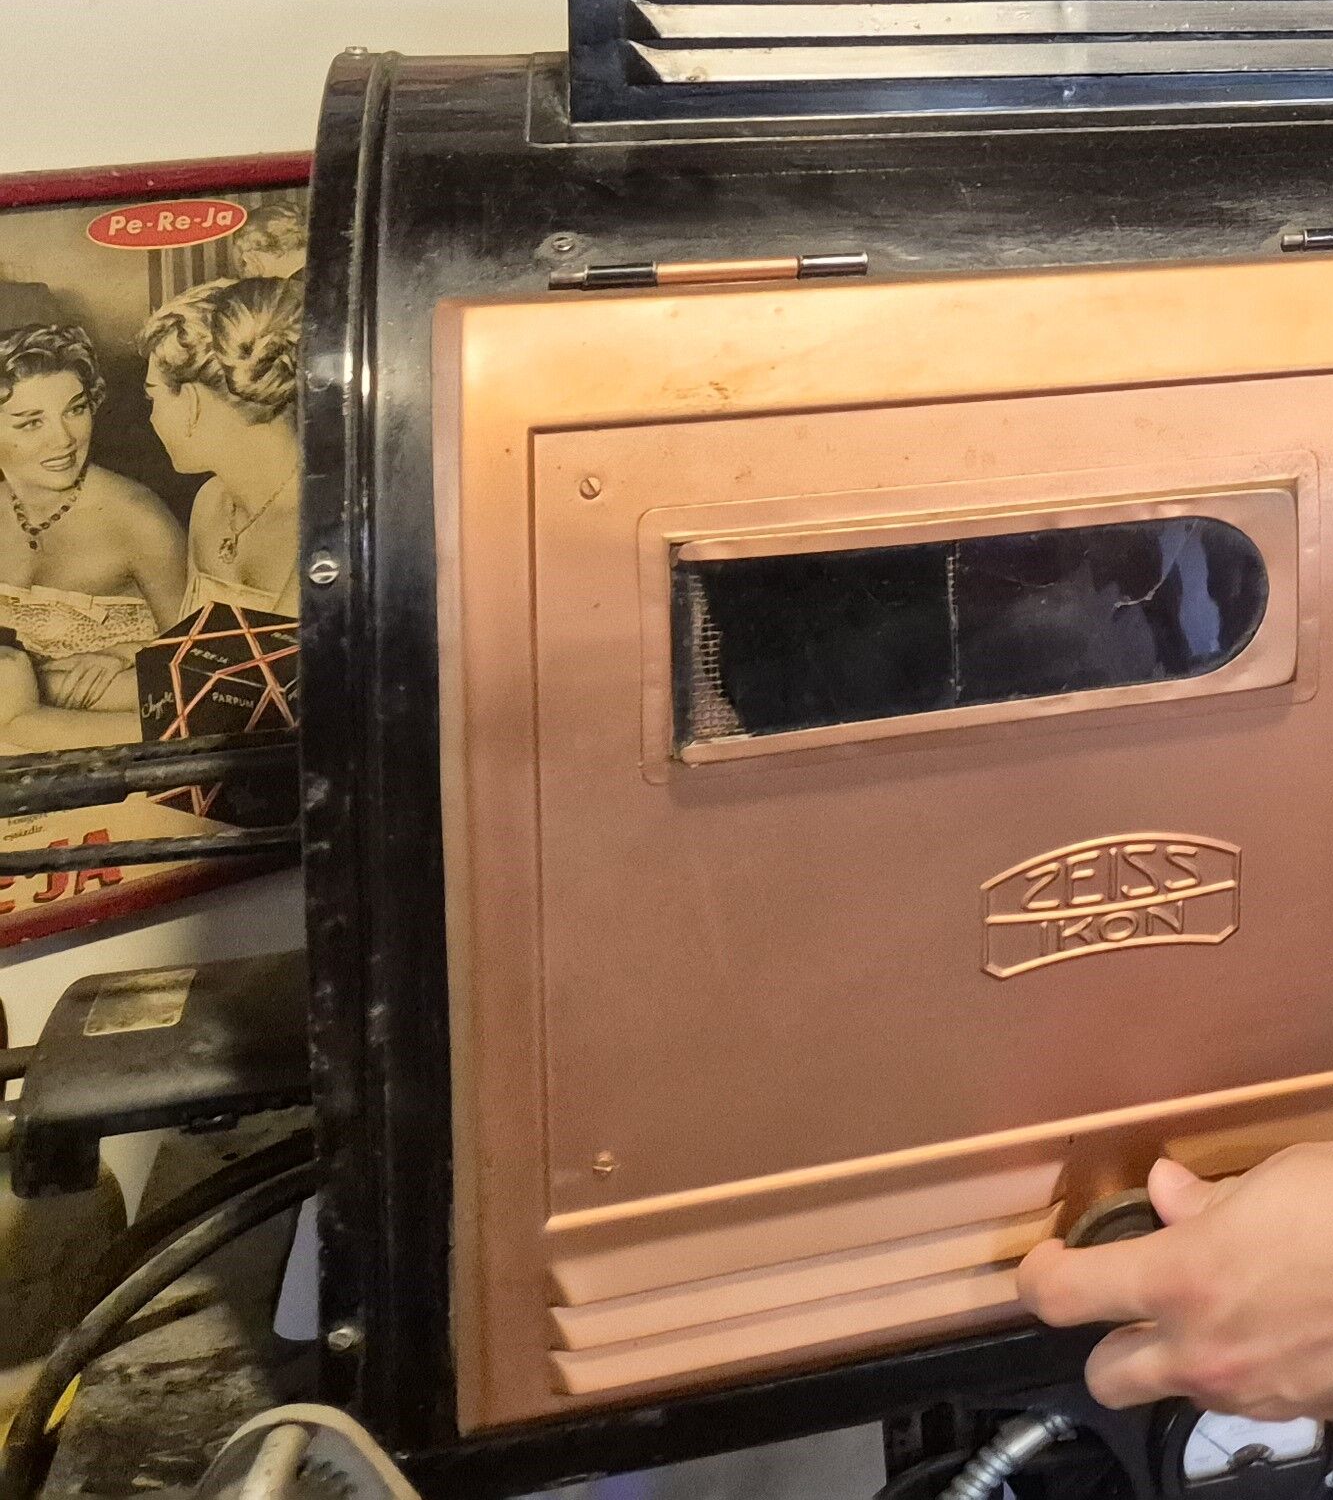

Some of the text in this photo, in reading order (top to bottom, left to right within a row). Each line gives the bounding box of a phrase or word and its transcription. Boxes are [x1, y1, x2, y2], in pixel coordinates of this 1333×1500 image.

[108, 207, 233, 237] Pe-Re-Ja
[1021, 843, 1199, 910] ZEISS
[1040, 900, 1184, 957] IKON
